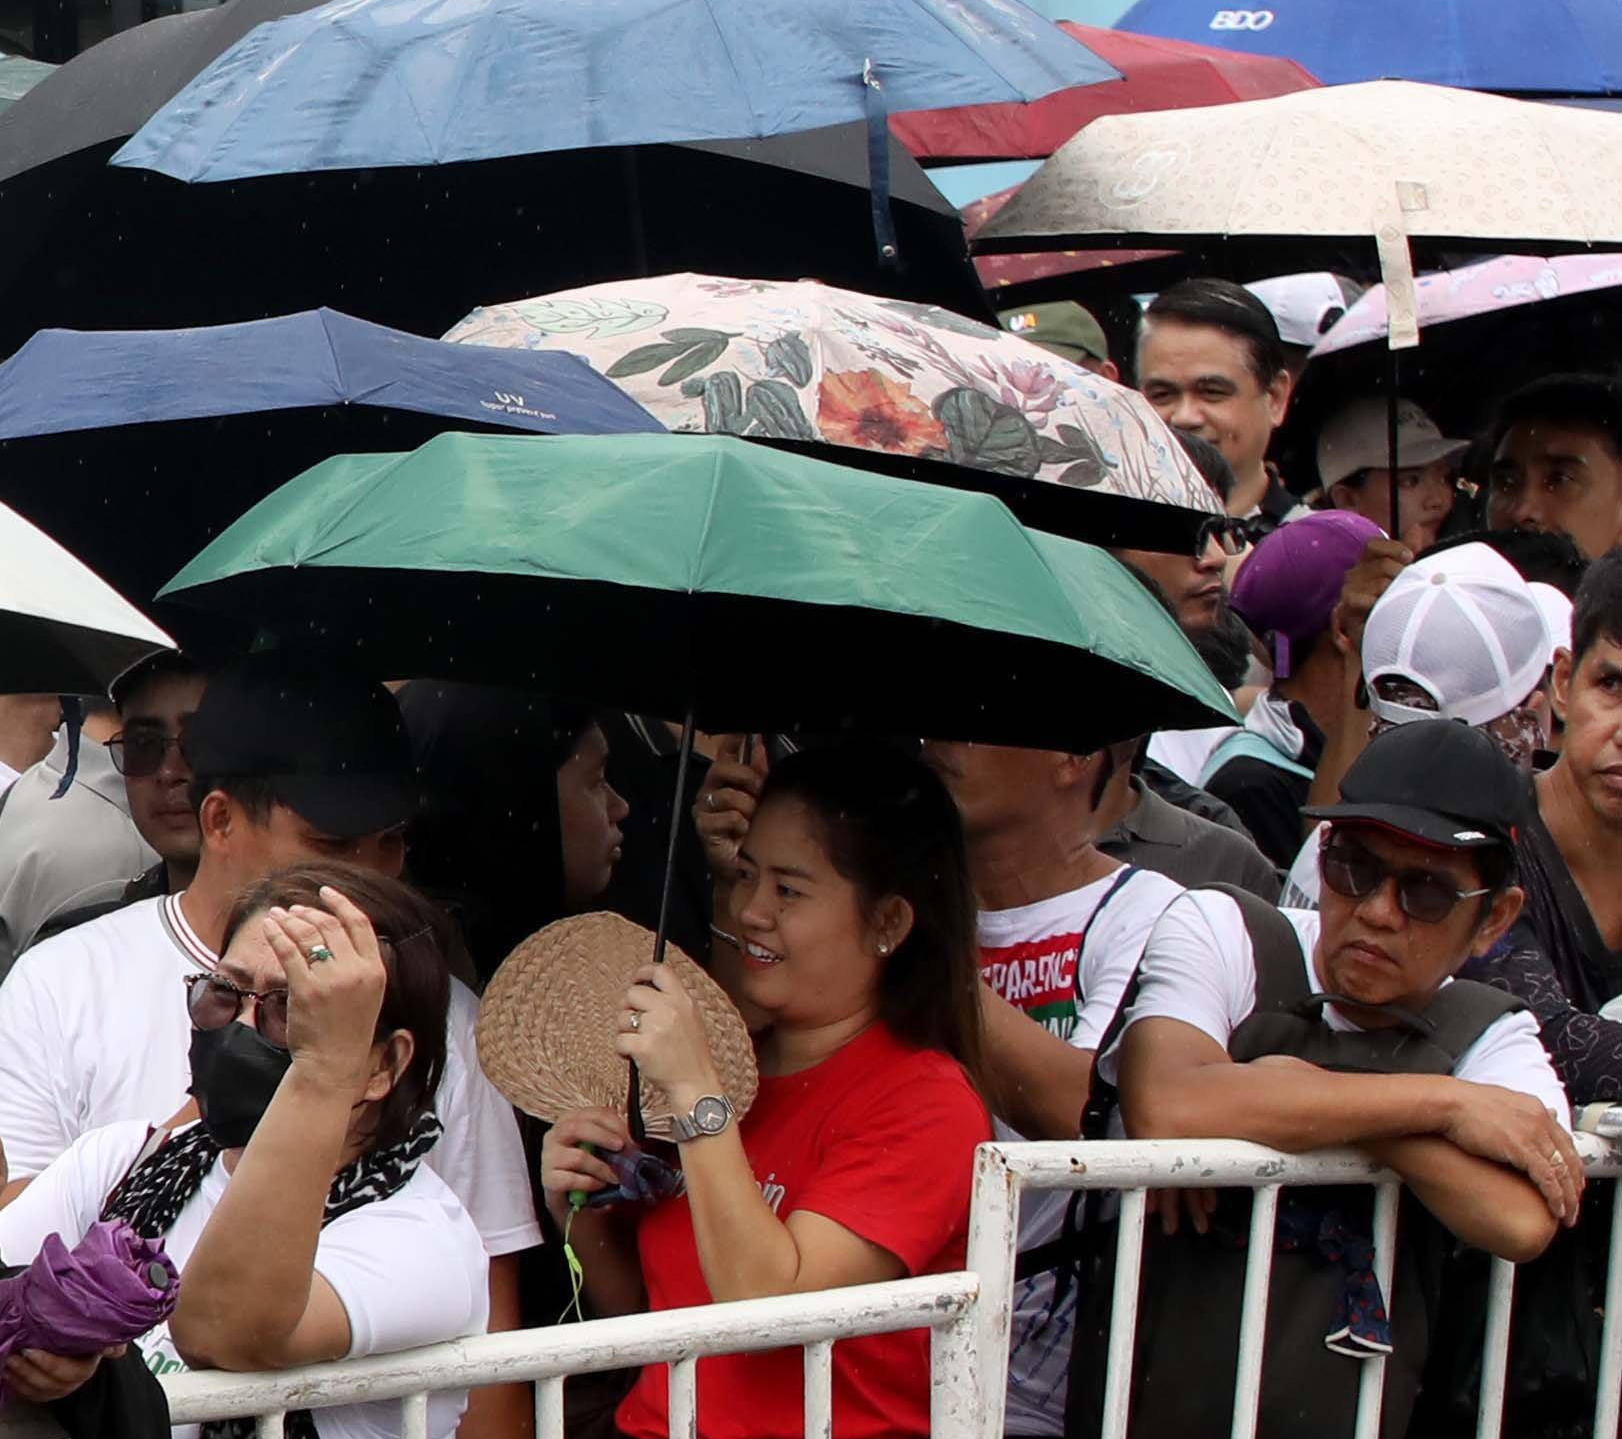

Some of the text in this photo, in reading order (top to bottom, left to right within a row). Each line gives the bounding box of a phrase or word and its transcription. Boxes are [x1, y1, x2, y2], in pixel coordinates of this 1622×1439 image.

[1209, 10, 1275, 32] BDO
[494, 391, 524, 407] UV
[981, 948, 1078, 1002] PARENC
